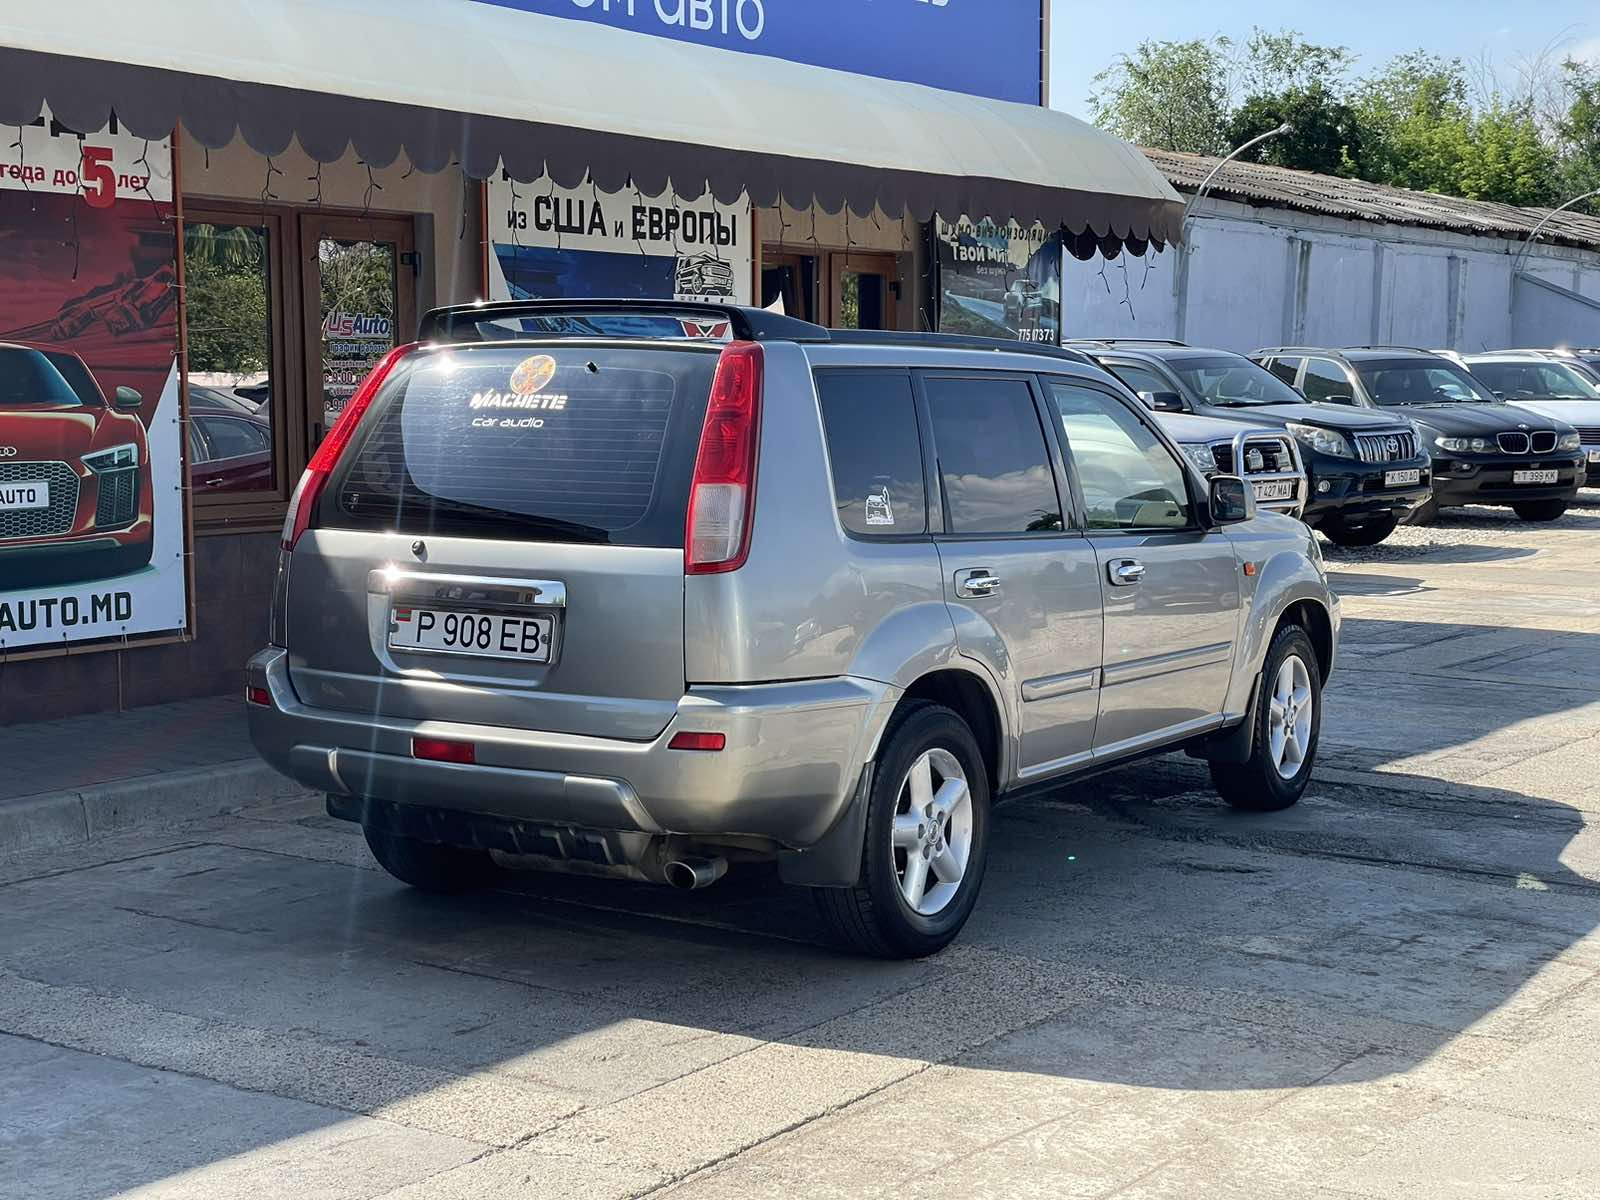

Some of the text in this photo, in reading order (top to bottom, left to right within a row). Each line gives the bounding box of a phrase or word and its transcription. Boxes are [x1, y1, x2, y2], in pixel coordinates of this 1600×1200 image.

[53, 170, 76, 187] до
[82, 146, 117, 208] 5
[117, 174, 150, 189] лет
[507, 195, 737, 246] из США и ЕВРОПЫ
[469, 388, 568, 410] MACHETE
[472, 416, 544, 428] car audio
[0, 591, 132, 632] AUTO.MD
[416, 611, 541, 654] P 908 EB
